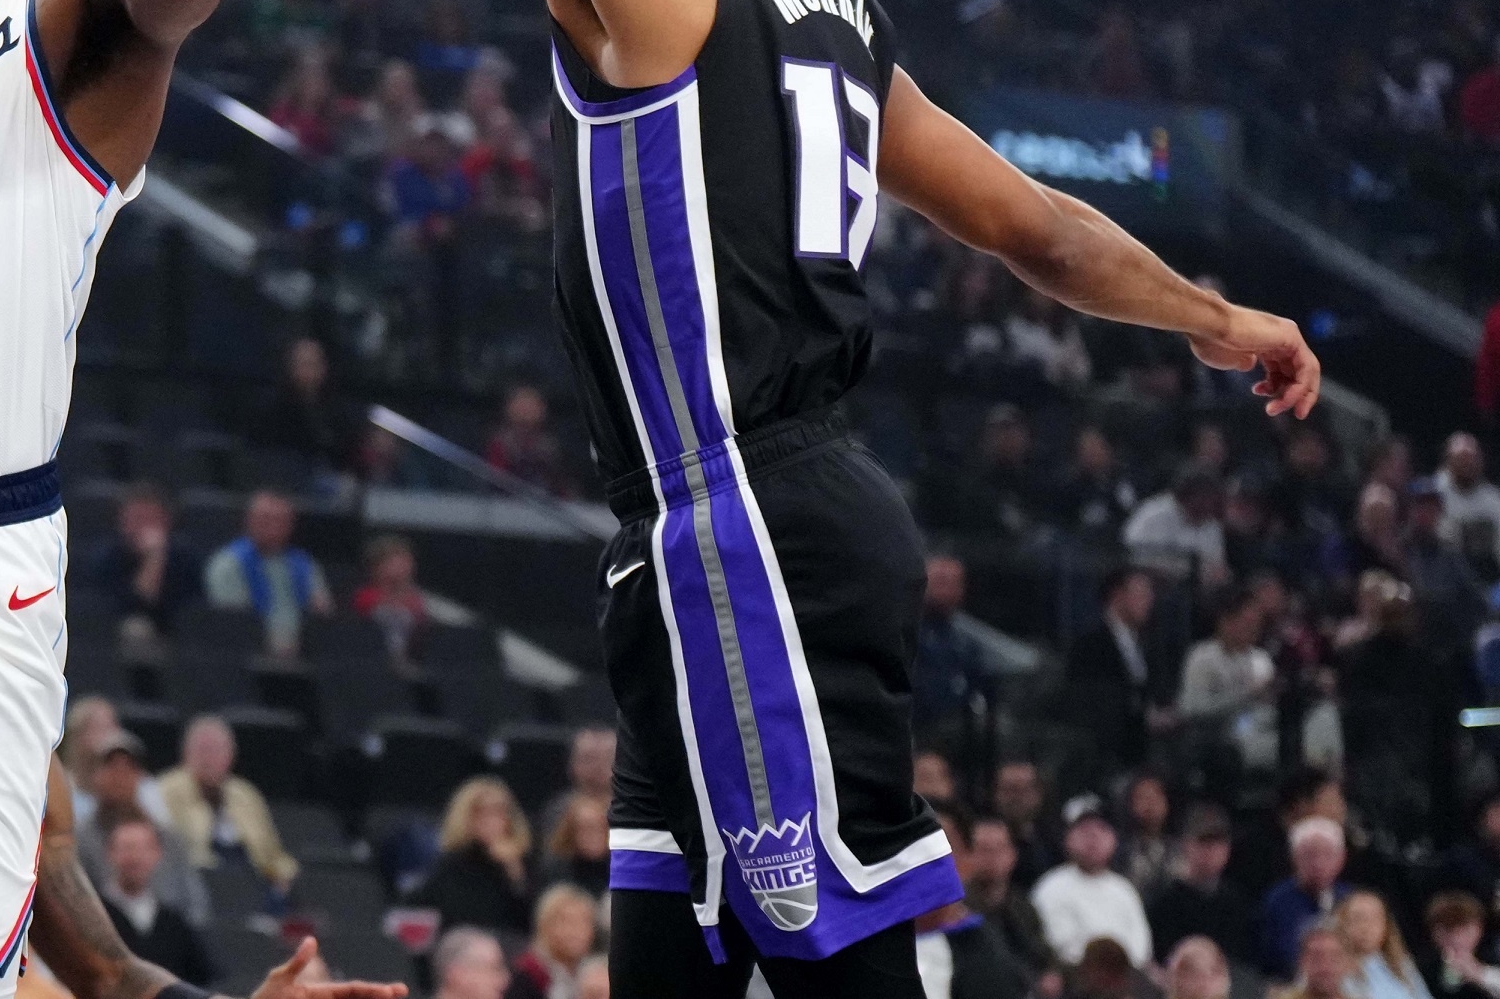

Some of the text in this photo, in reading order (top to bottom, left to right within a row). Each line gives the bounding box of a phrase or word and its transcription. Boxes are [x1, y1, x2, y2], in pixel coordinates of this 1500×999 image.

[781, 55, 879, 273] 13
[740, 847, 813, 867] SACRAMENTO
[744, 862, 817, 891] KINGS
